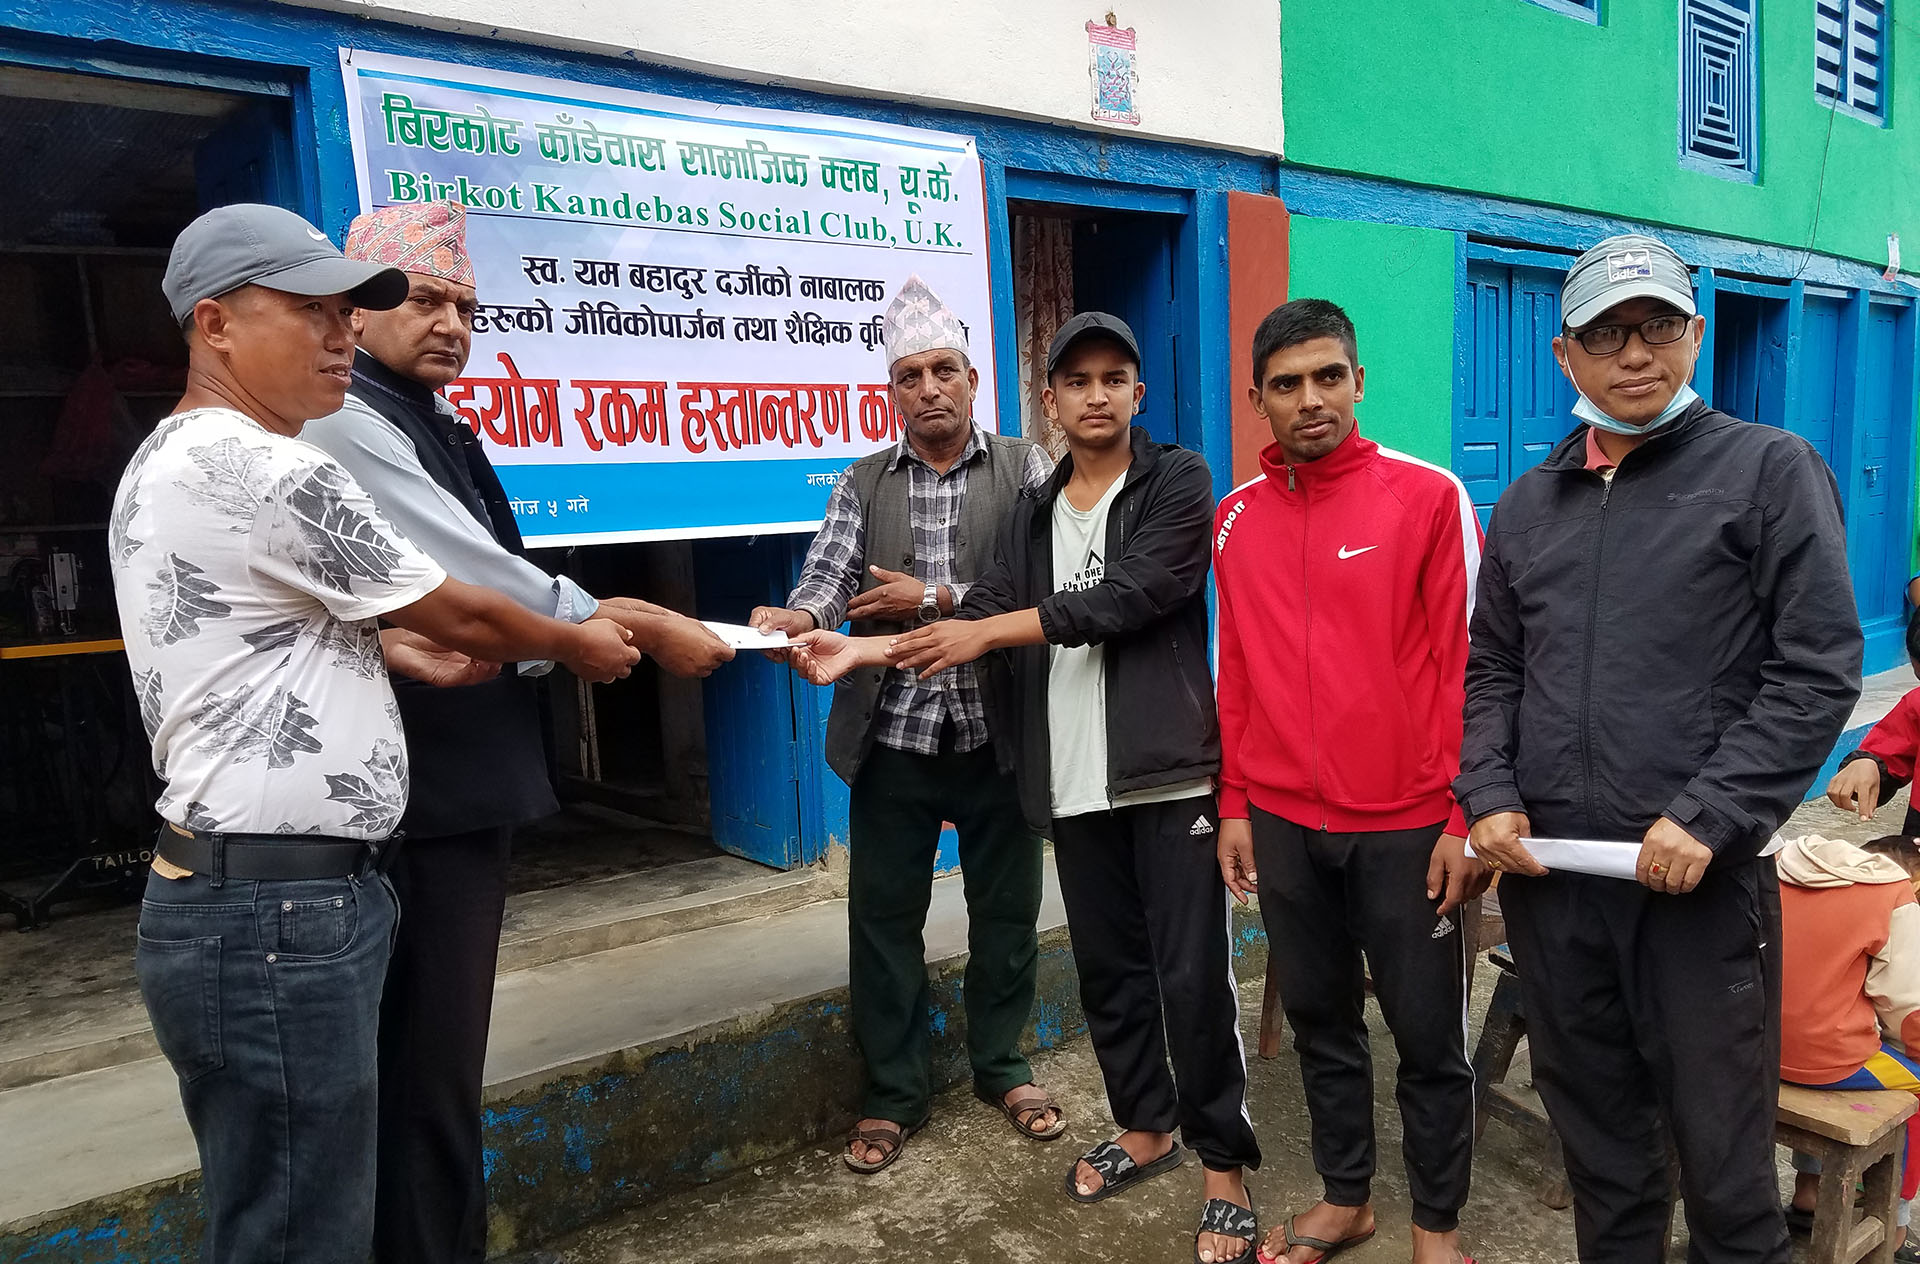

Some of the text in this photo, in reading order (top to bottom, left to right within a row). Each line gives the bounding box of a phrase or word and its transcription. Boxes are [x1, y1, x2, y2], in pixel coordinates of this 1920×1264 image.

[381, 93, 524, 155] बिरकोट
[676, 139, 810, 188] सामाजिक
[818, 155, 889, 205] क्लब,
[389, 171, 963, 248] Birkot Kandebas Social Club, U.K.
[522, 256, 885, 302] स्व. यम बहादुर दर्जीको नाबालक
[562, 301, 725, 340] जीविकोपार्जन
[733, 316, 777, 342] तथा
[784, 311, 852, 347] शैक्षिक
[570, 380, 670, 451] रकम
[677, 382, 850, 454] हस्तान्तरण
[566, 494, 590, 514] गते
[1222, 511, 1236, 530] DO
[1233, 499, 1246, 514] IT
[92, 851, 152, 870] TAILO
